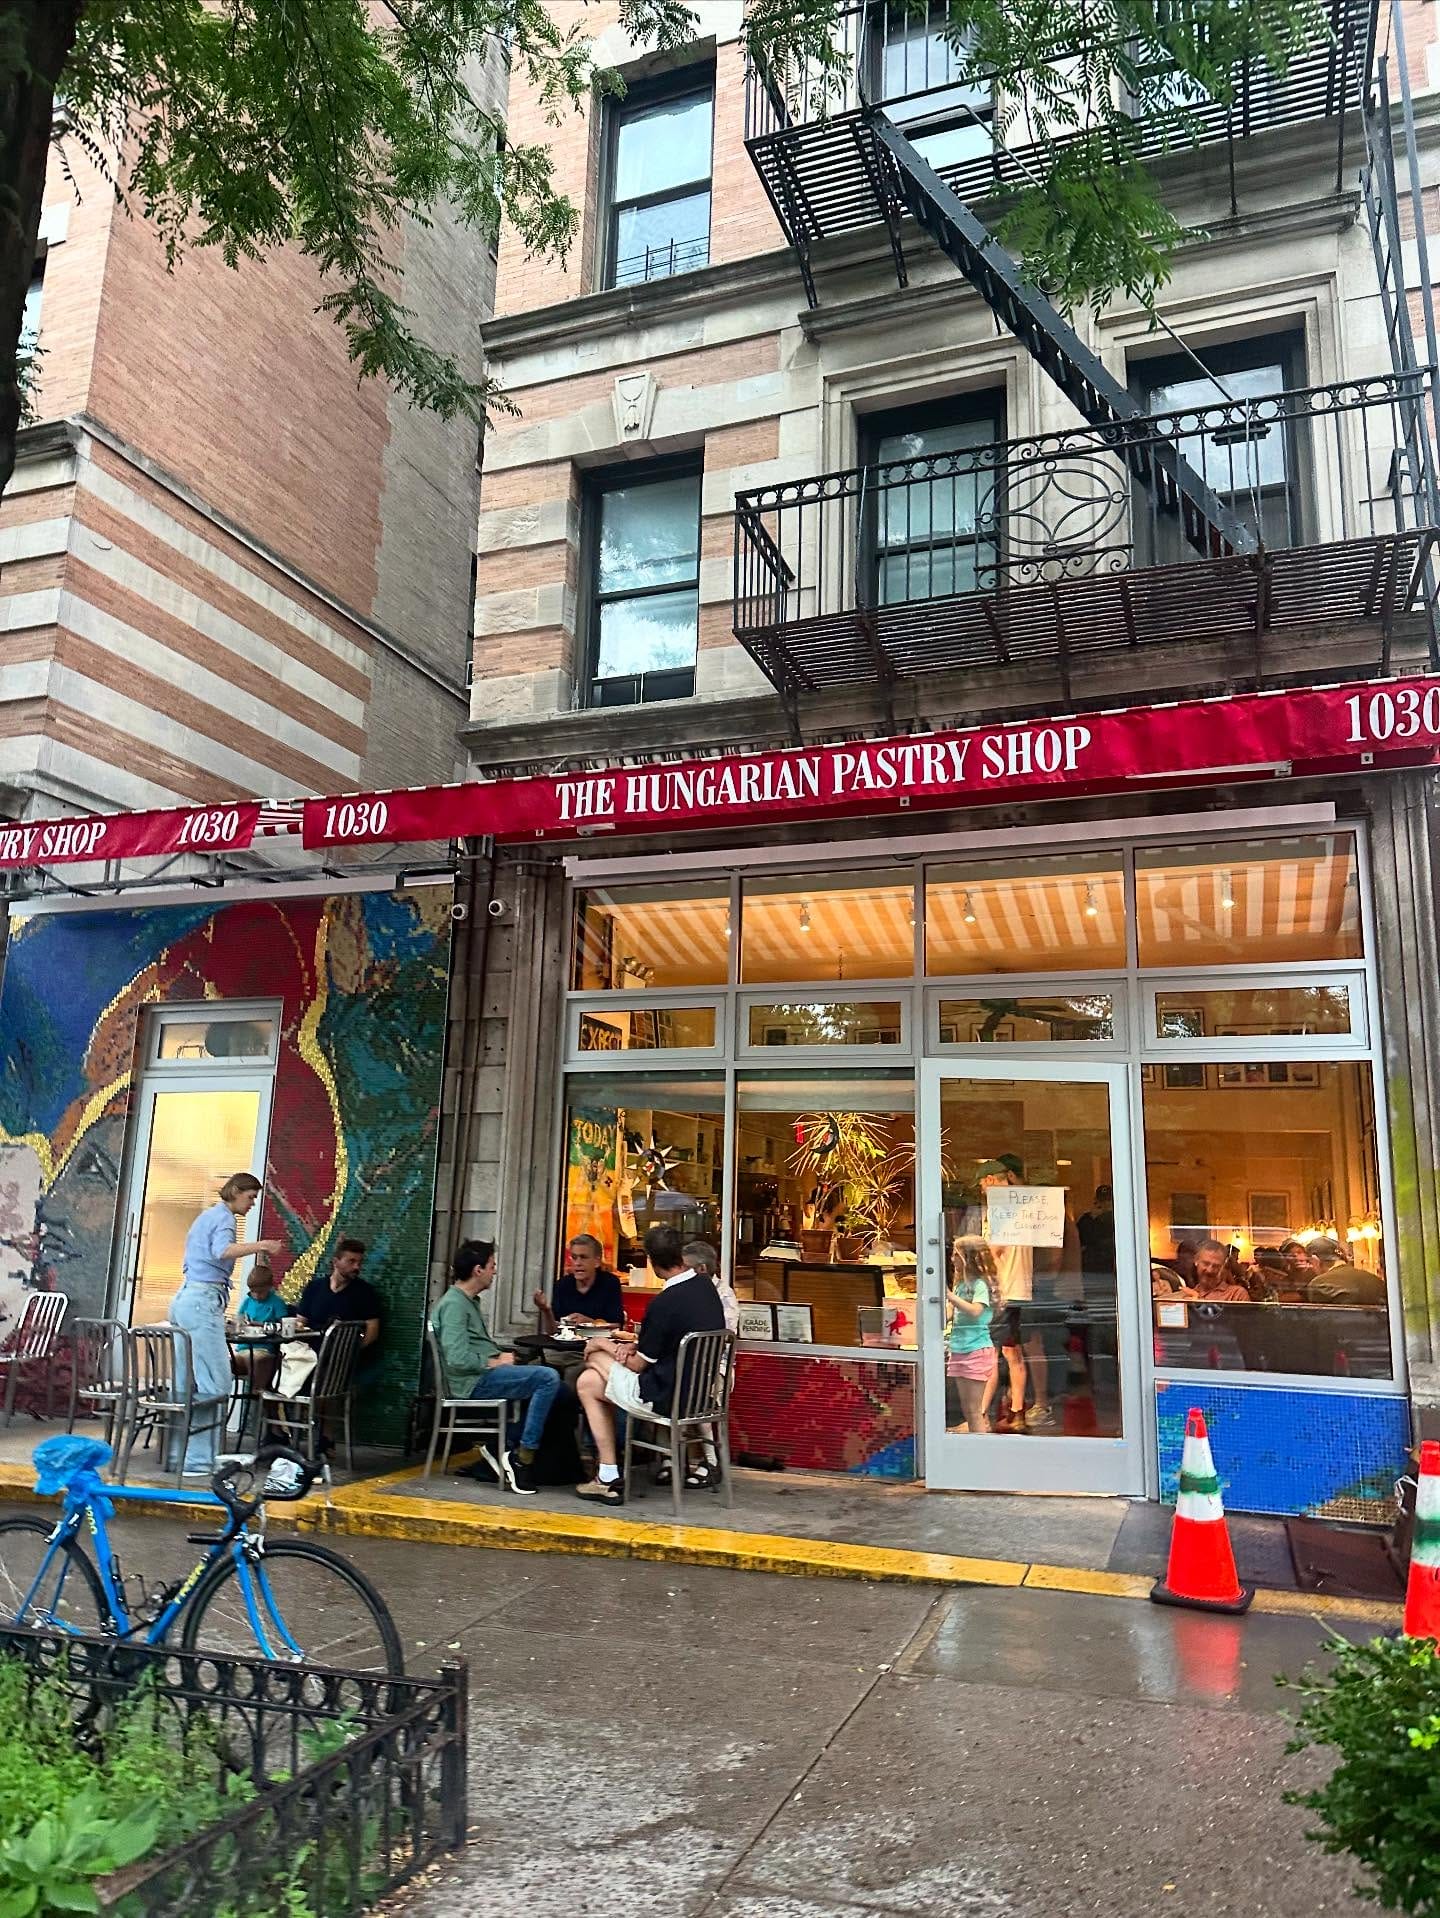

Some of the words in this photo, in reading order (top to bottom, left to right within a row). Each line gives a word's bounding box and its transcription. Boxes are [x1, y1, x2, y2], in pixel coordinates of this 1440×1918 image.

[1345, 687, 1440, 741] 1030
[556, 779, 616, 819] THE
[625, 757, 820, 812] HUNGARIAN
[832, 739, 972, 794] PASTRY
[982, 727, 1091, 778] SHOP
[177, 811, 239, 845] 1030
[324, 802, 388, 837] 1030
[38, 823, 107, 857] SHOP
[573, 1119, 617, 1149] TODAY
[743, 1325, 770, 1333] PENDING
